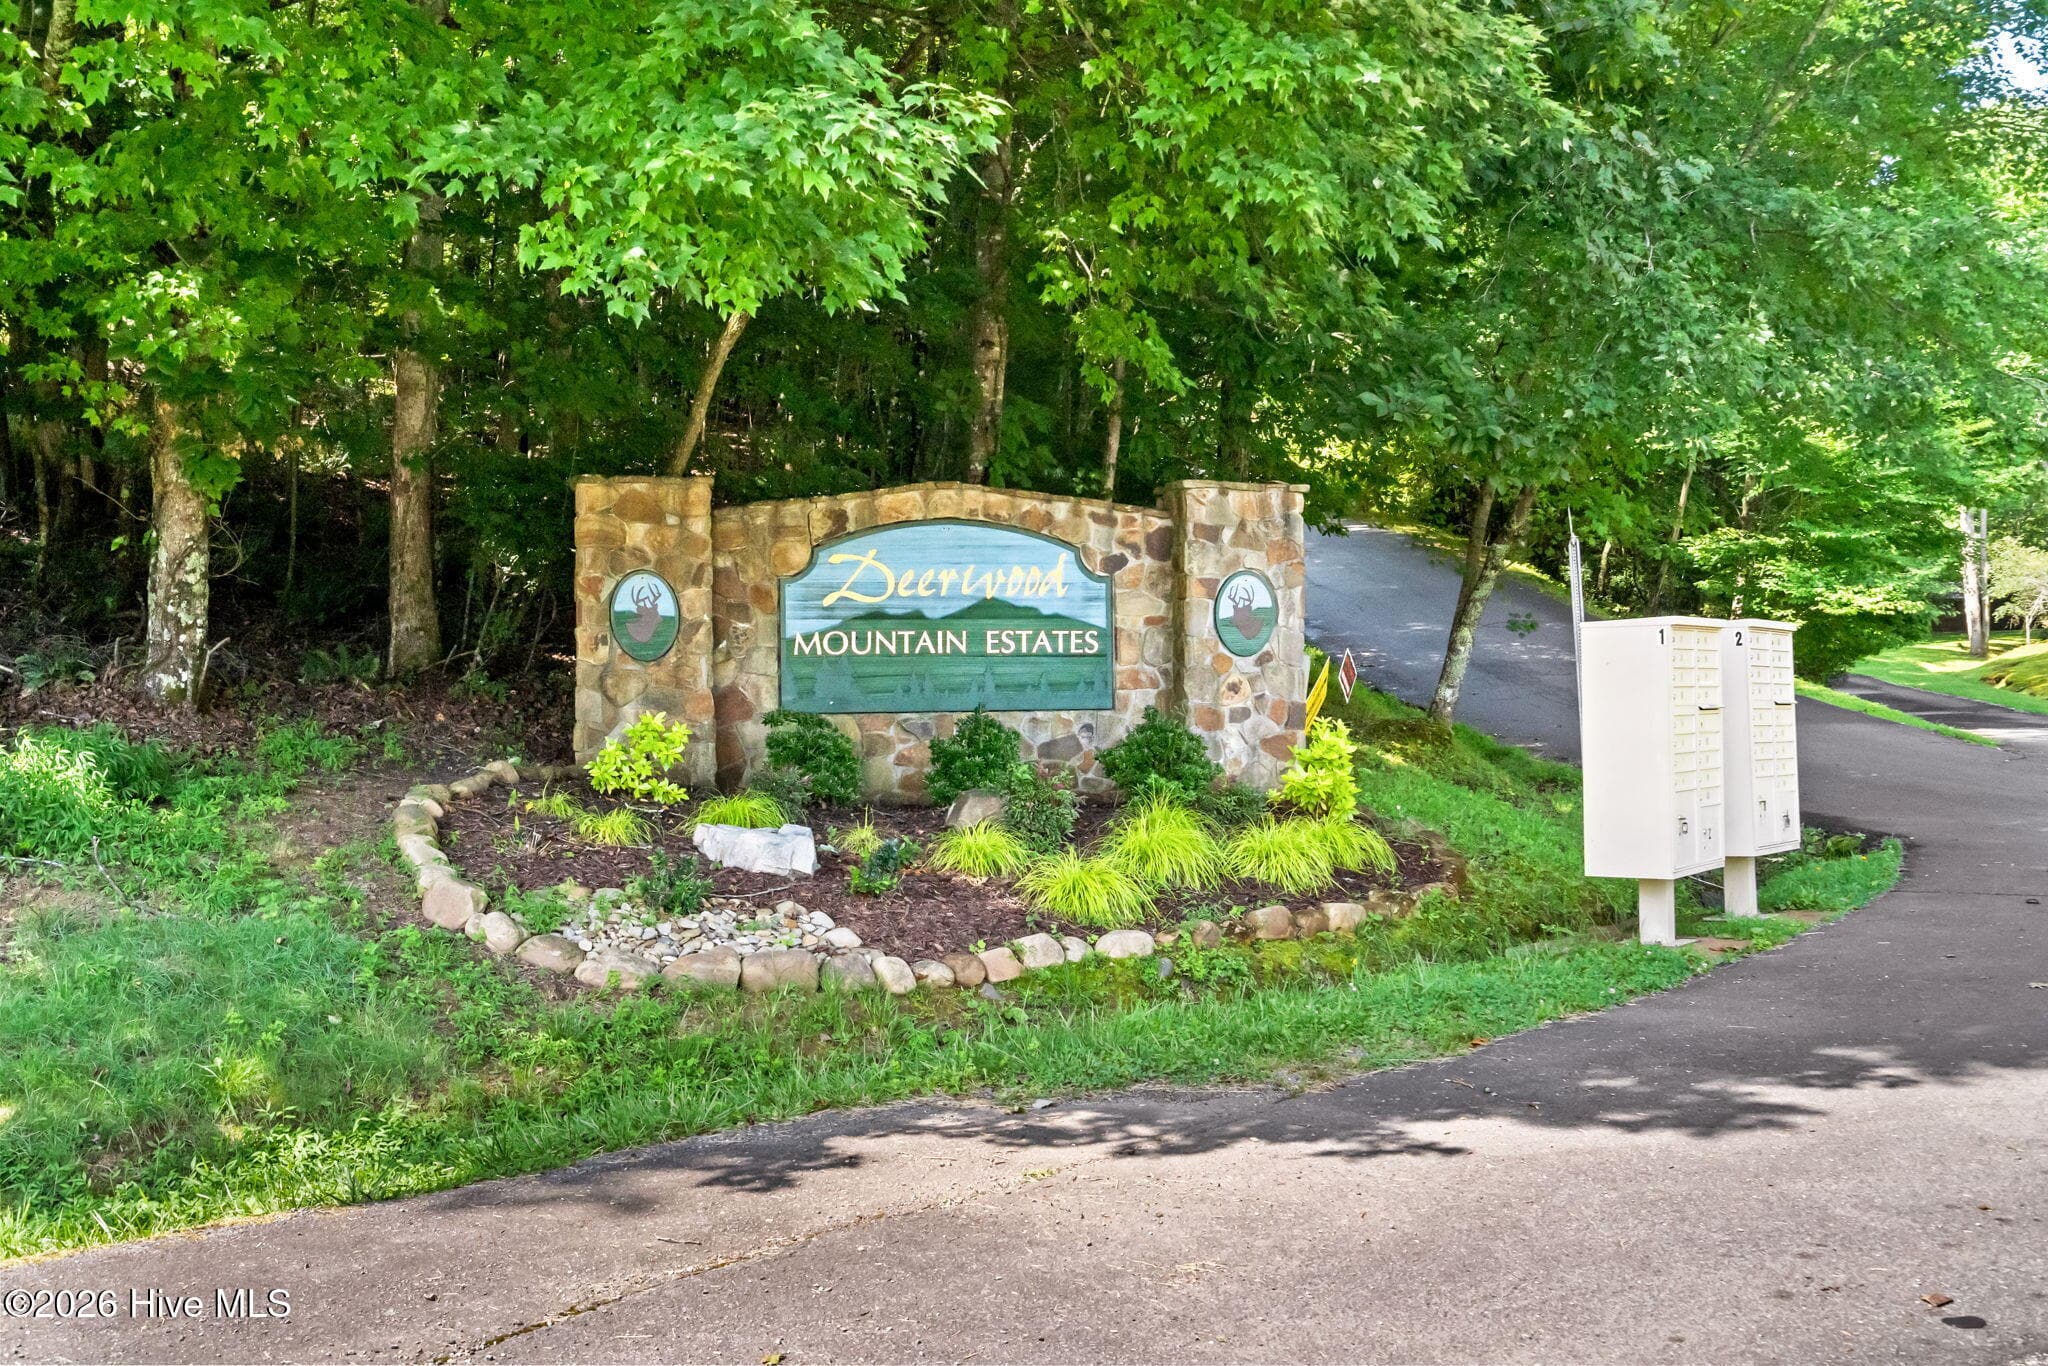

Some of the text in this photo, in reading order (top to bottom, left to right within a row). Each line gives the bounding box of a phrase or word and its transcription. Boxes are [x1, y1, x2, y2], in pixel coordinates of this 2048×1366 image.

[822, 549, 1070, 607] Deerwood
[793, 629, 1099, 656] MOUNTAIN ESTATES
[1659, 628, 1665, 645] 1
[1735, 631, 1742, 646] 2
